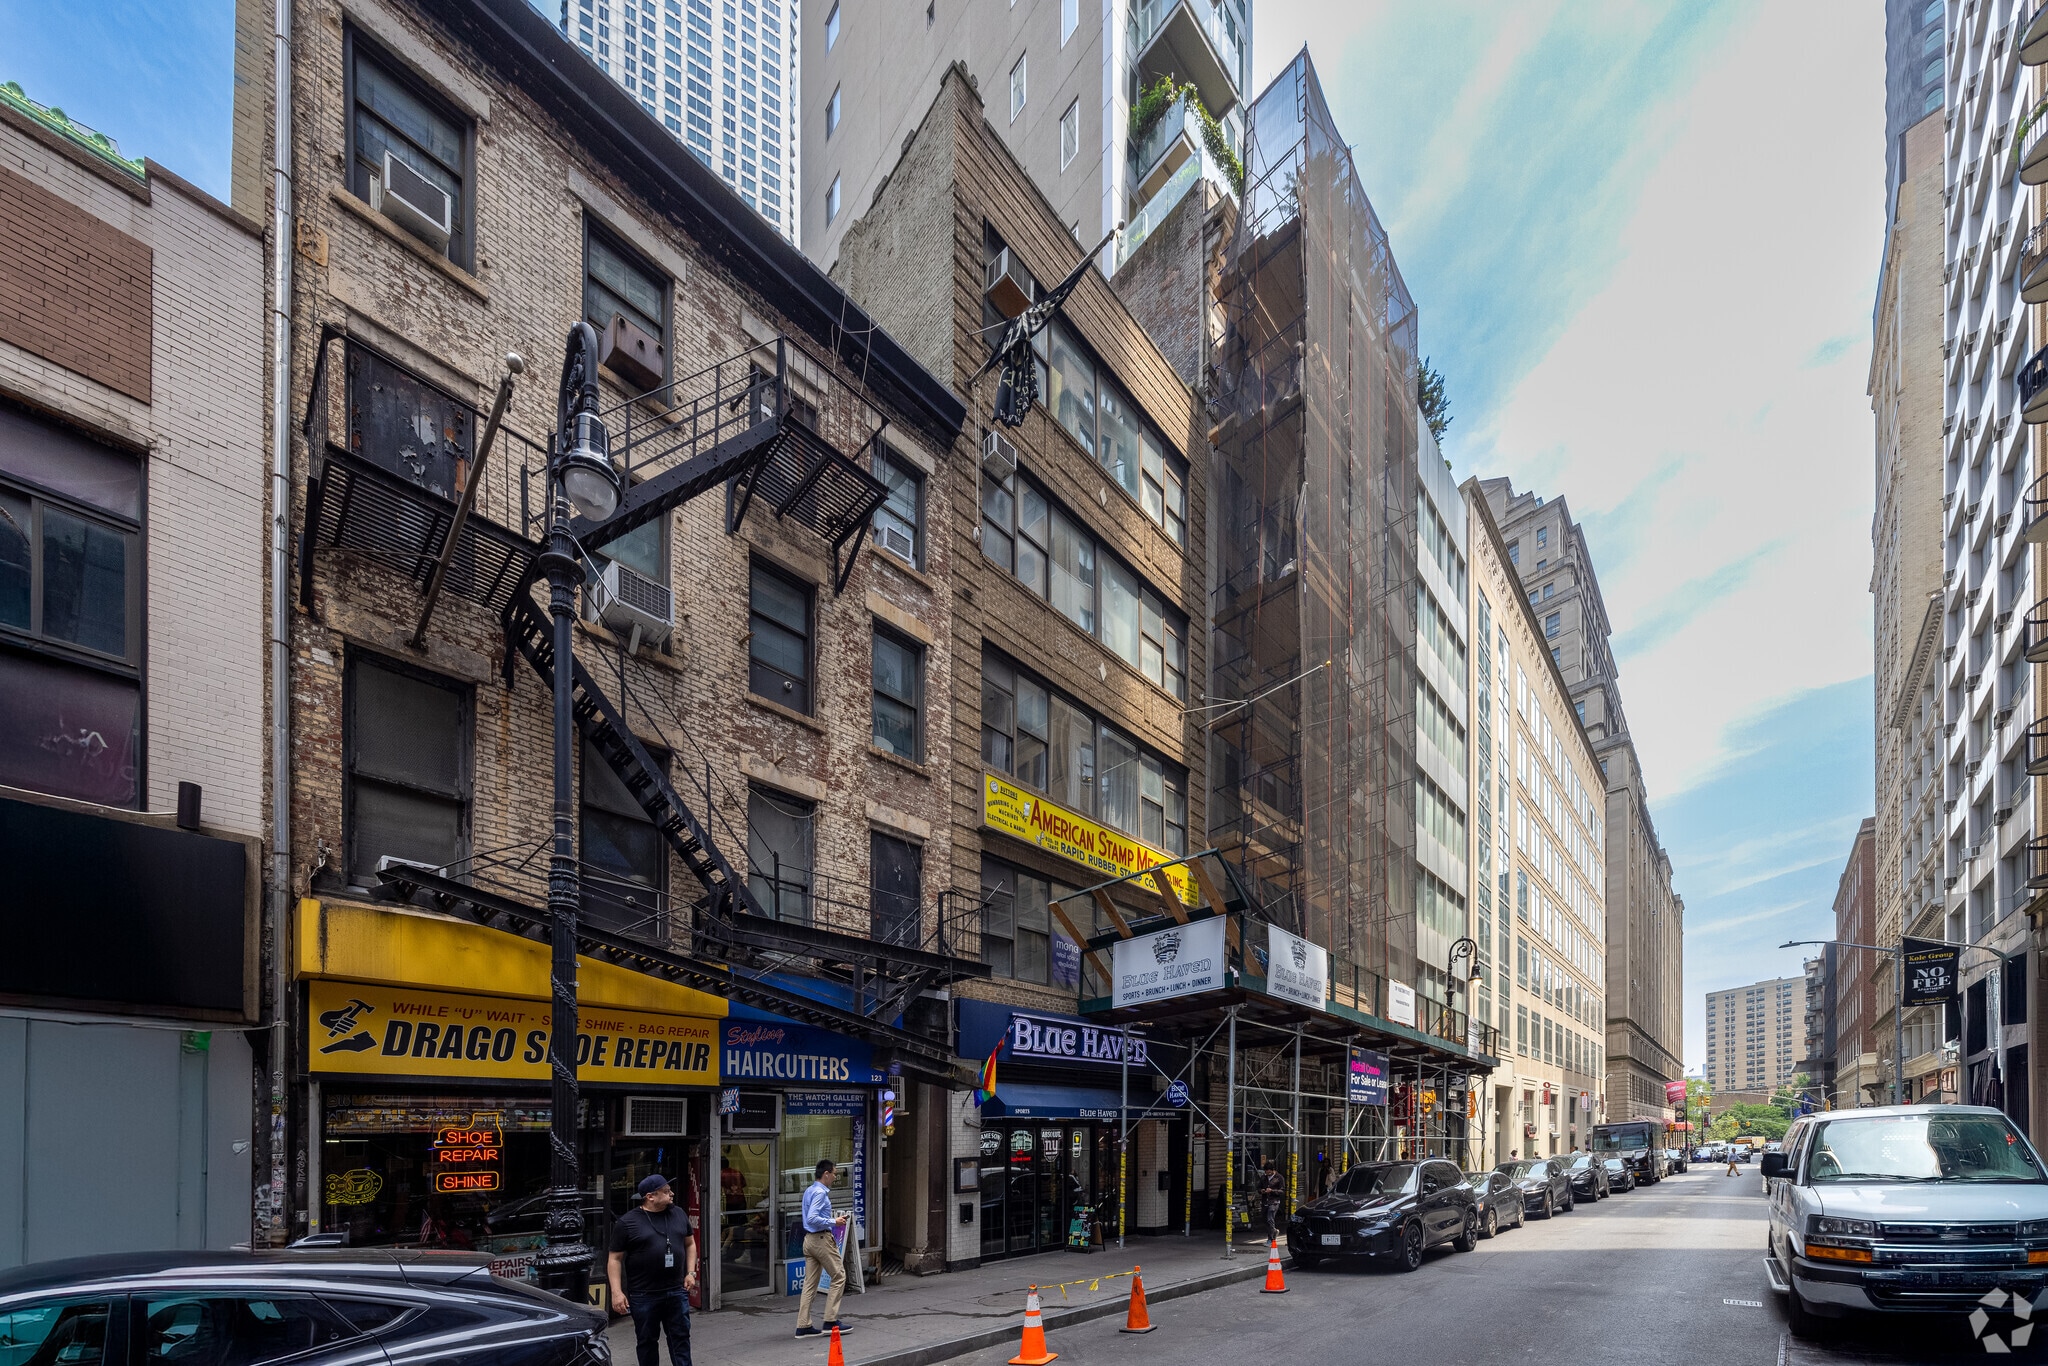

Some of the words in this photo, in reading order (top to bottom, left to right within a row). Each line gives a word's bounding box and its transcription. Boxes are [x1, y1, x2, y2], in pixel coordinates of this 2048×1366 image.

[1030, 799, 1094, 852] AMERICAN
[1098, 831, 1134, 867] STAMP
[1061, 842, 1085, 861] RAPID
[1088, 854, 1117, 875] RUBBER
[1928, 952, 1954, 960] Group
[1916, 966, 1945, 979] NO
[1123, 990, 1140, 1000] SPORTS
[1146, 986, 1166, 997] BRUNCH
[1170, 982, 1186, 992] LUNCH
[1192, 976, 1212, 988] DINNER
[1912, 975, 1951, 989] FEE
[393, 1002, 449, 1018] WHILE
[486, 1010, 526, 1024] WAIT
[585, 1018, 625, 1032] SHINE
[638, 1024, 665, 1036] BAG
[668, 1027, 710, 1039] REPAIR
[727, 1026, 786, 1048] Styling
[381, 1019, 517, 1062] DRAGO
[523, 1030, 609, 1067] SOE
[613, 1037, 711, 1072] REPAIR
[727, 1049, 850, 1081] HAIRCUTTERS
[871, 1074, 883, 1082] 123
[1351, 1073, 1360, 1085] For
[1361, 1074, 1371, 1086] Sale
[788, 1093, 803, 1101] THE
[805, 1094, 831, 1102] WATCH
[833, 1094, 864, 1102] GALLERY
[446, 1131, 493, 1144] SHOE
[440, 1149, 498, 1162] REPAIR
[443, 1175, 493, 1189] SHINE
